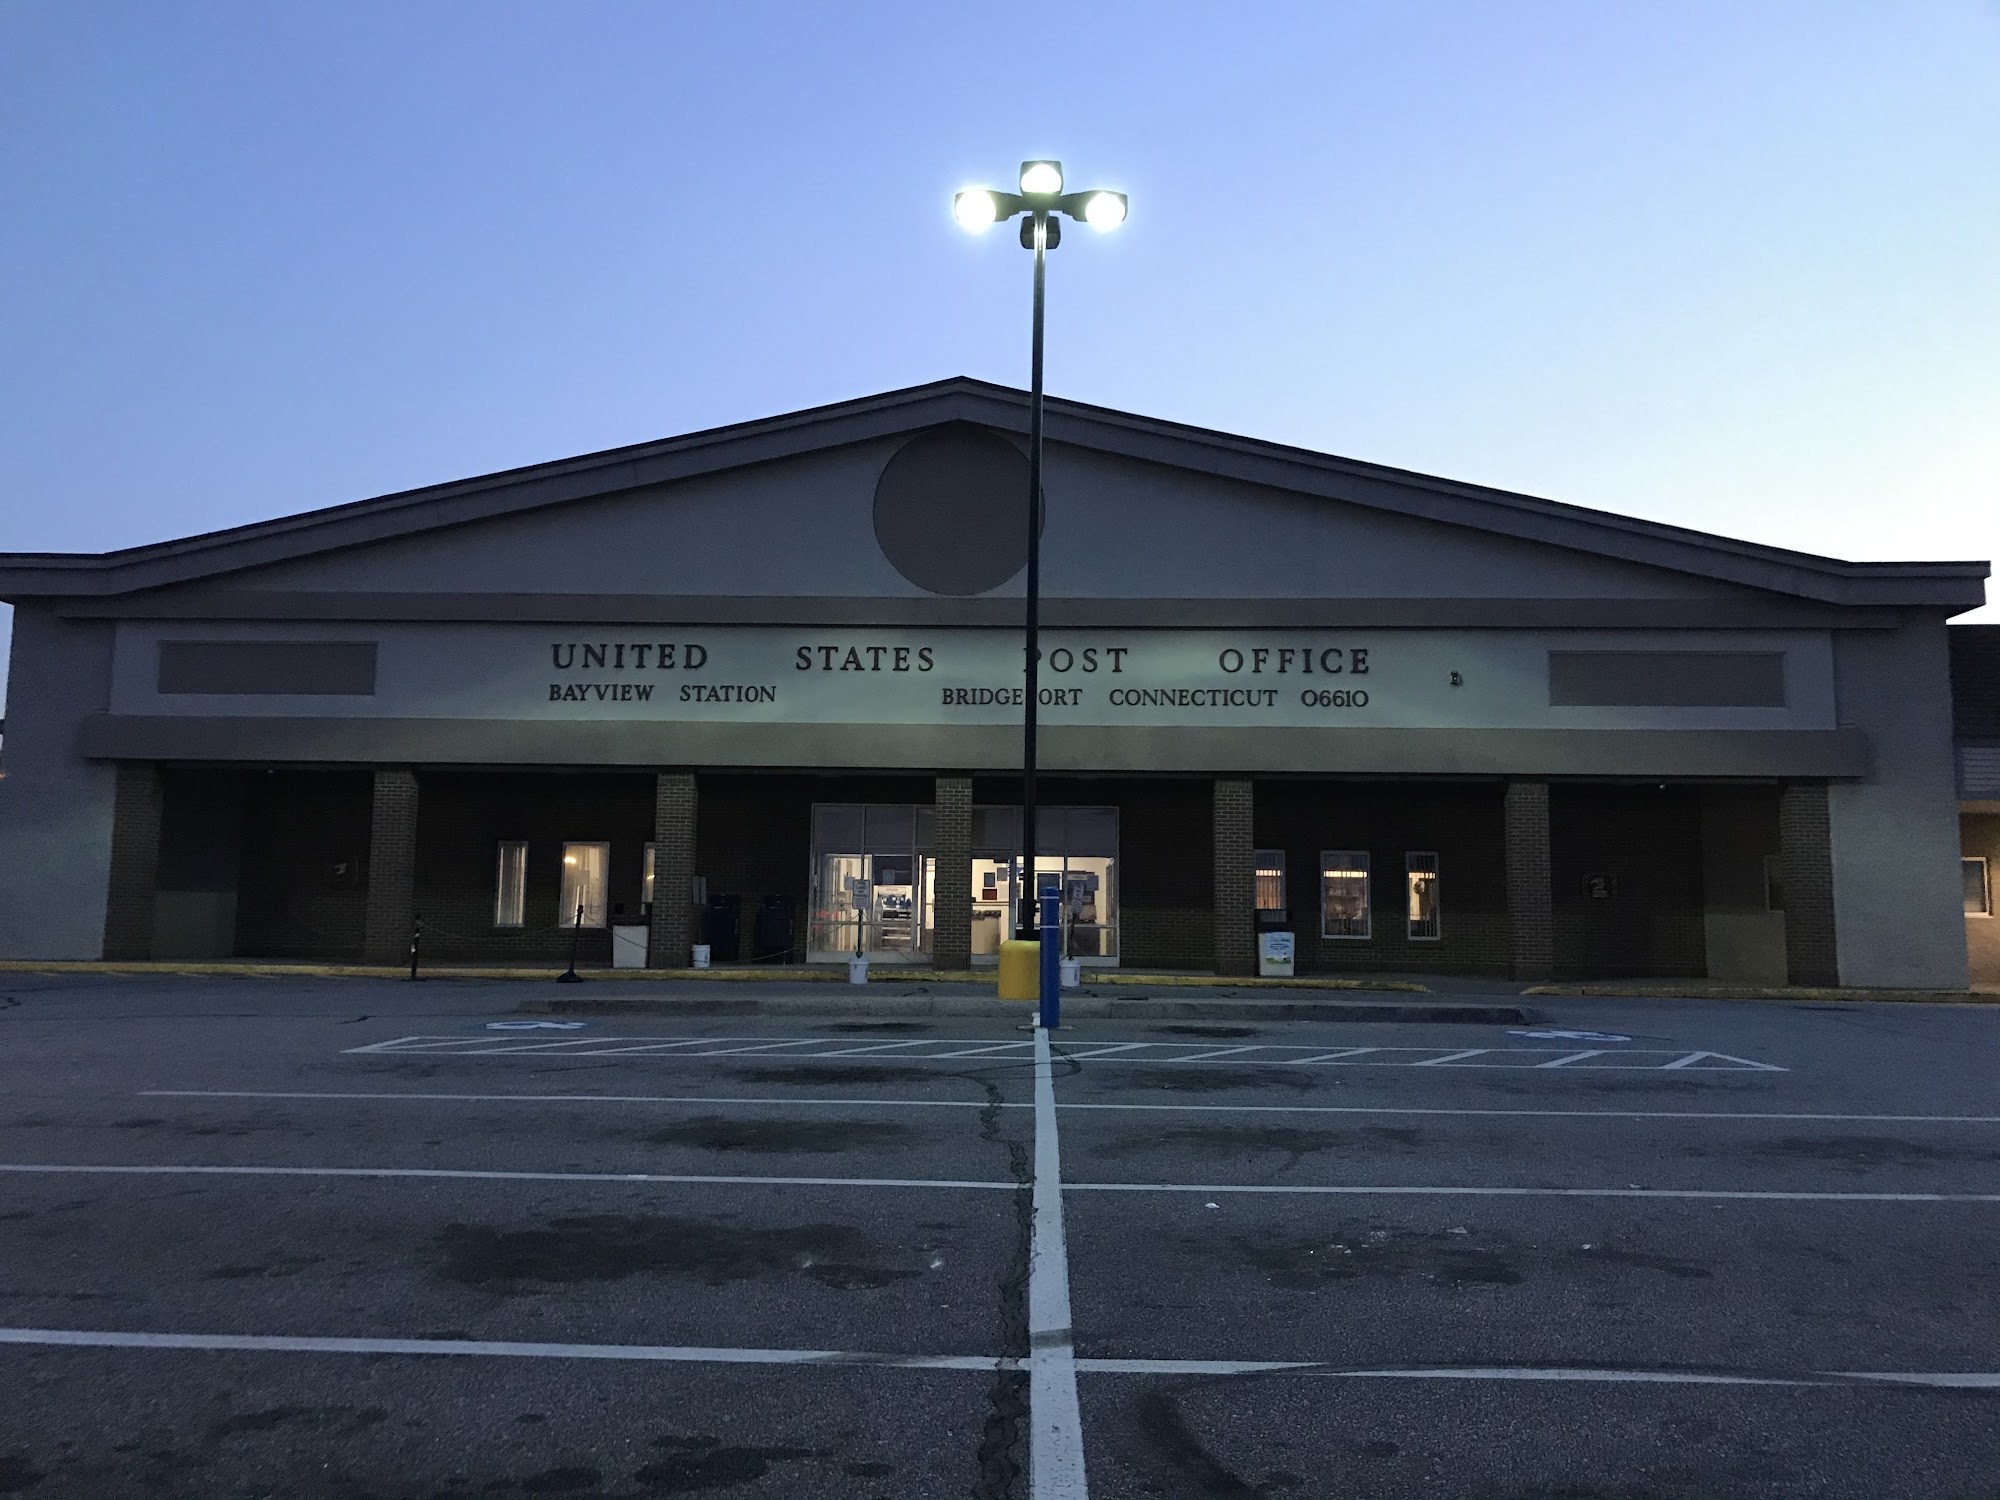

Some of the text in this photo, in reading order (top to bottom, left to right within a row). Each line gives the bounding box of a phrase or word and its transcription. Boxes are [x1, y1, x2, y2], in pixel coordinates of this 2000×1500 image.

[551, 643, 1370, 674] UNITED STATES OST OFFICE
[549, 684, 777, 703] BAYVIEW STATION
[942, 687, 1370, 708] BRIDGEORT CONNECTICUT 06610
